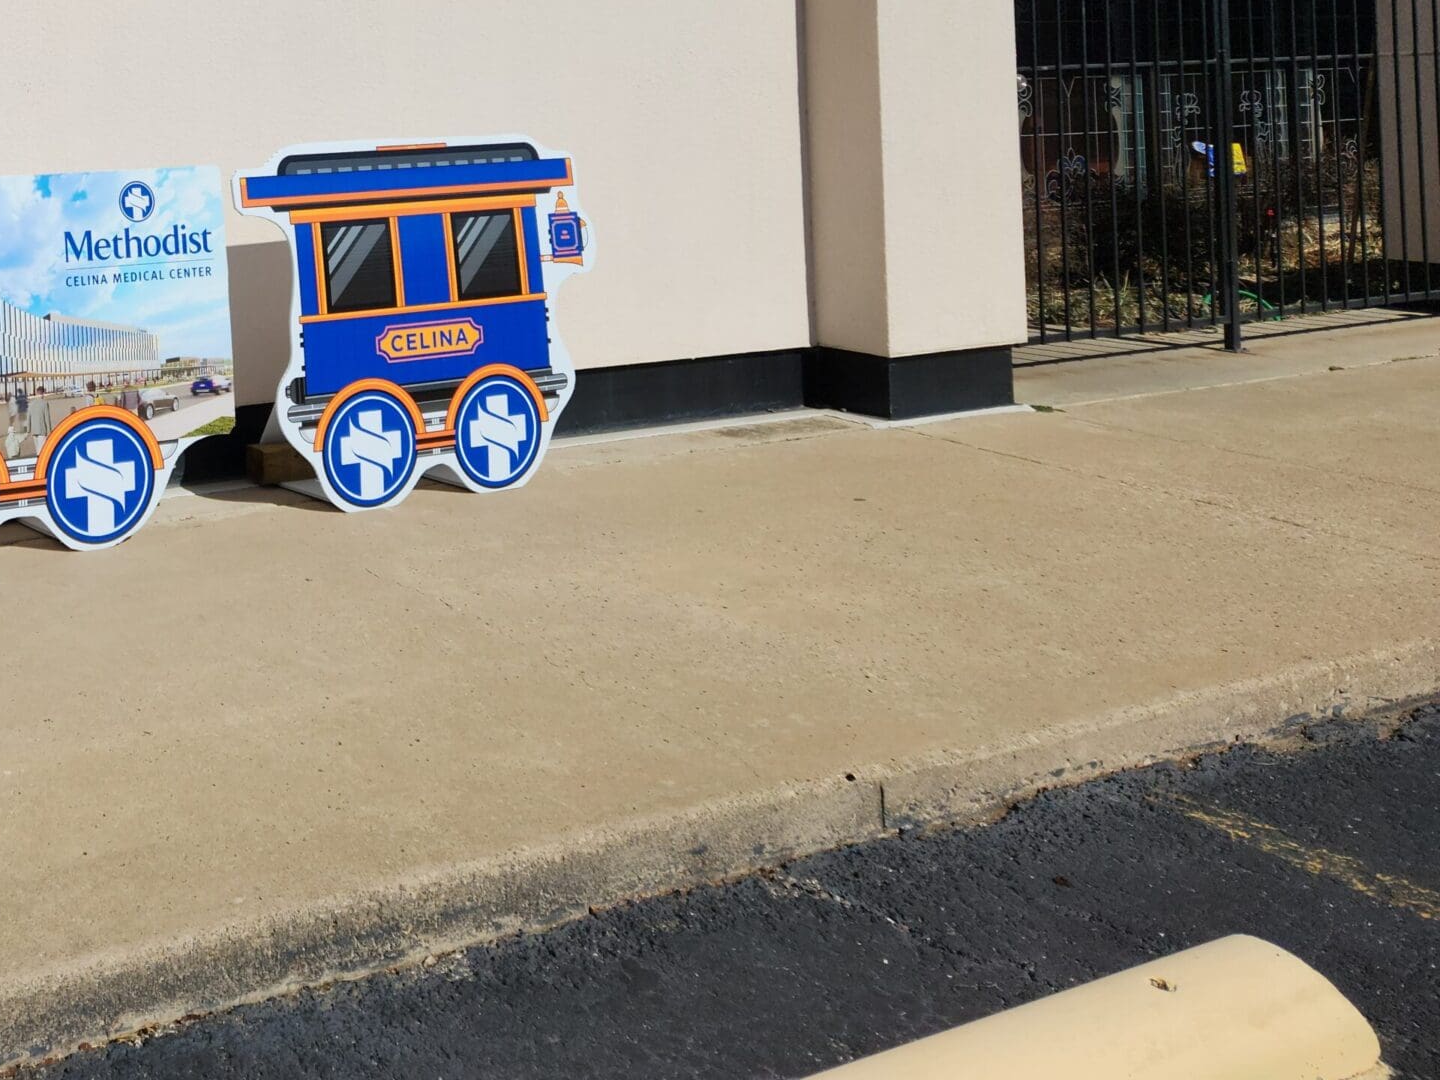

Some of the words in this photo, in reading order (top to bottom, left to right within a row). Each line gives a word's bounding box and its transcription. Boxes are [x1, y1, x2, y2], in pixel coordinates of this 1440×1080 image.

[63, 224, 213, 263] Methodist
[65, 273, 108, 287] CELINA
[112, 270, 164, 284] MEDICAL
[169, 266, 212, 279] CENTER
[391, 328, 469, 352] CELINA
